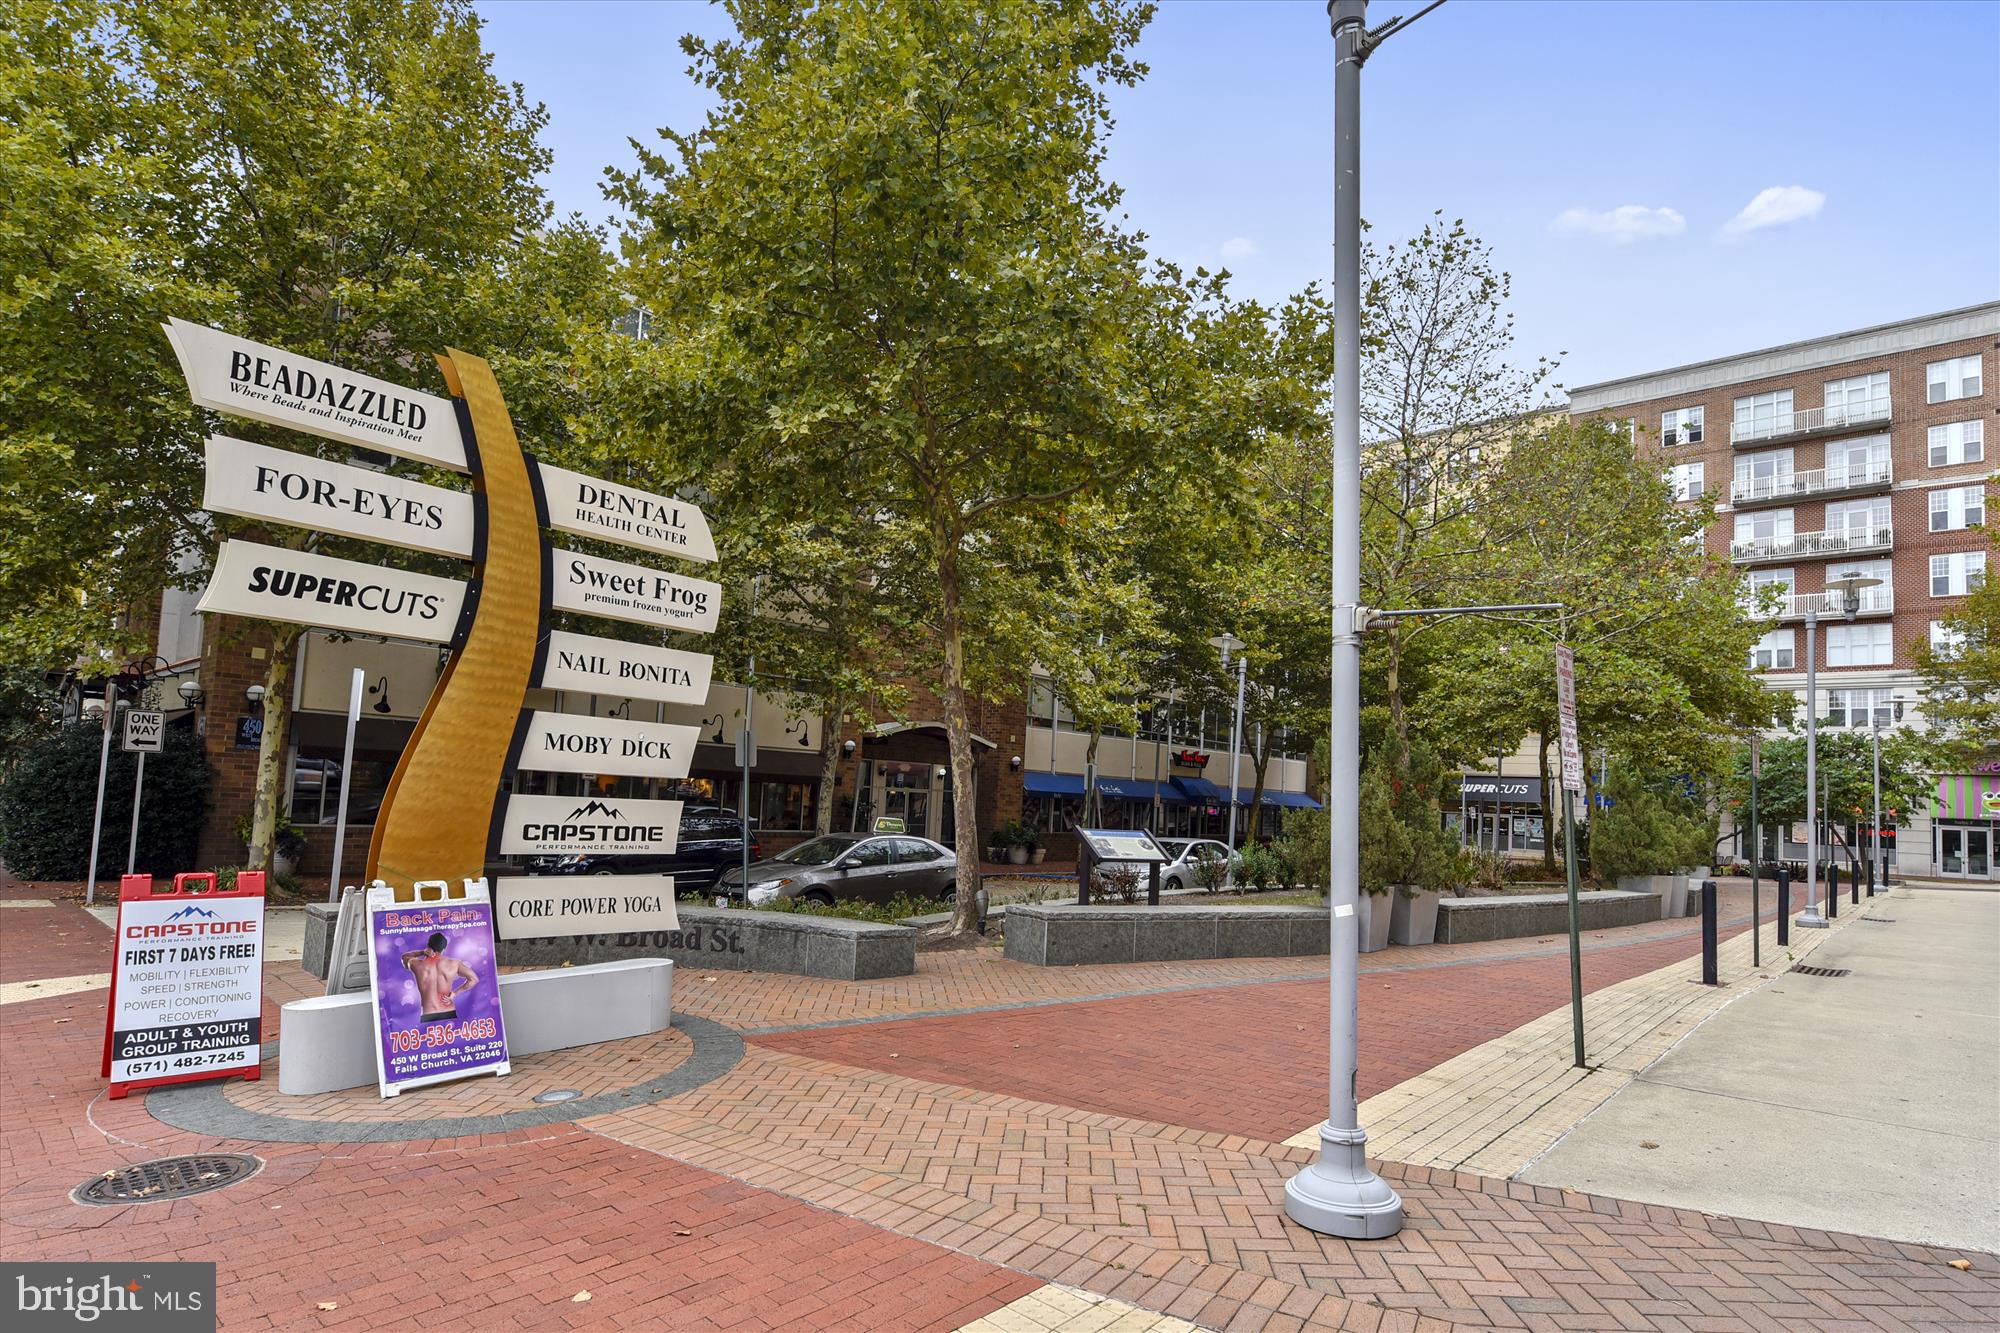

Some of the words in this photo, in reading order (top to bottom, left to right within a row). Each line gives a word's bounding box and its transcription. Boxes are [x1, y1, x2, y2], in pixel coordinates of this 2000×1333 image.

[230, 351, 427, 431] BEADAZZLED
[230, 381, 269, 402] Where
[272, 393, 306, 413] Beads
[309, 403, 333, 419] and
[335, 412, 394, 436] Inspiration
[397, 427, 424, 443] Meet
[253, 466, 443, 530] FOR-EYES
[578, 483, 686, 529] DENTAL
[576, 508, 631, 532] HEALTH
[636, 524, 687, 546] CENTER
[248, 566, 439, 619] SUPERCUTS
[570, 560, 646, 597] Sweet
[654, 577, 708, 614] Frog
[584, 591, 630, 608] premium
[632, 599, 662, 613] frozen
[664, 605, 694, 619] yogurt
[557, 651, 610, 676] NAIL
[619, 660, 692, 687] BONITA
[130, 725, 159, 736] WAY
[131, 713, 159, 725] ONE
[243, 719, 262, 734] 450
[544, 732, 613, 755] MOBY
[621, 739, 672, 760] DICK
[522, 823, 664, 842] CAPSTONE
[508, 899, 554, 918] CORE
[560, 897, 617, 917] POWER
[623, 896, 662, 913] YOGA
[126, 920, 256, 939] CAPSTONE
[380, 920, 487, 936] SunnyMassageTherapySpa.com
[385, 911, 434, 928] Back
[138, 937, 202, 945] PERFORMANCE
[616, 927, 702, 951] Broad
[710, 927, 746, 955] St.
[125, 948, 165, 966] FIRST
[169, 948, 177, 963] 7
[181, 946, 216, 963] DAYS
[219, 943, 256, 959] FREE!
[129, 970, 181, 982] MOBILITY
[189, 965, 250, 978] FLEXIBILITY
[141, 983, 176, 995] SPEED
[184, 979, 238, 992] STRENGTH
[124, 999, 166, 1011] POWER
[175, 991, 252, 1007] CONDITIONING
[159, 1009, 219, 1023] RECOVERY
[124, 1028, 179, 1044] ADULT
[182, 1027, 194, 1038] &
[197, 1022, 249, 1036] YOUTH
[390, 1017, 497, 1054] 703-536-4653
[122, 1042, 177, 1058] GROUP
[181, 1034, 250, 1050] TRAINING
[390, 1056, 407, 1066] 450
[409, 1055, 419, 1064] W
[421, 1051, 448, 1062] Broad
[450, 1047, 463, 1057] St.
[464, 1043, 487, 1054] Suite
[488, 1040, 503, 1050] 220
[126, 1060, 168, 1076] (571)
[174, 1051, 246, 1068] 482-7245
[395, 1063, 418, 1074] Falls
[421, 1058, 458, 1070] Church,
[460, 1054, 473, 1062] VA
[475, 1049, 501, 1060] 22046
